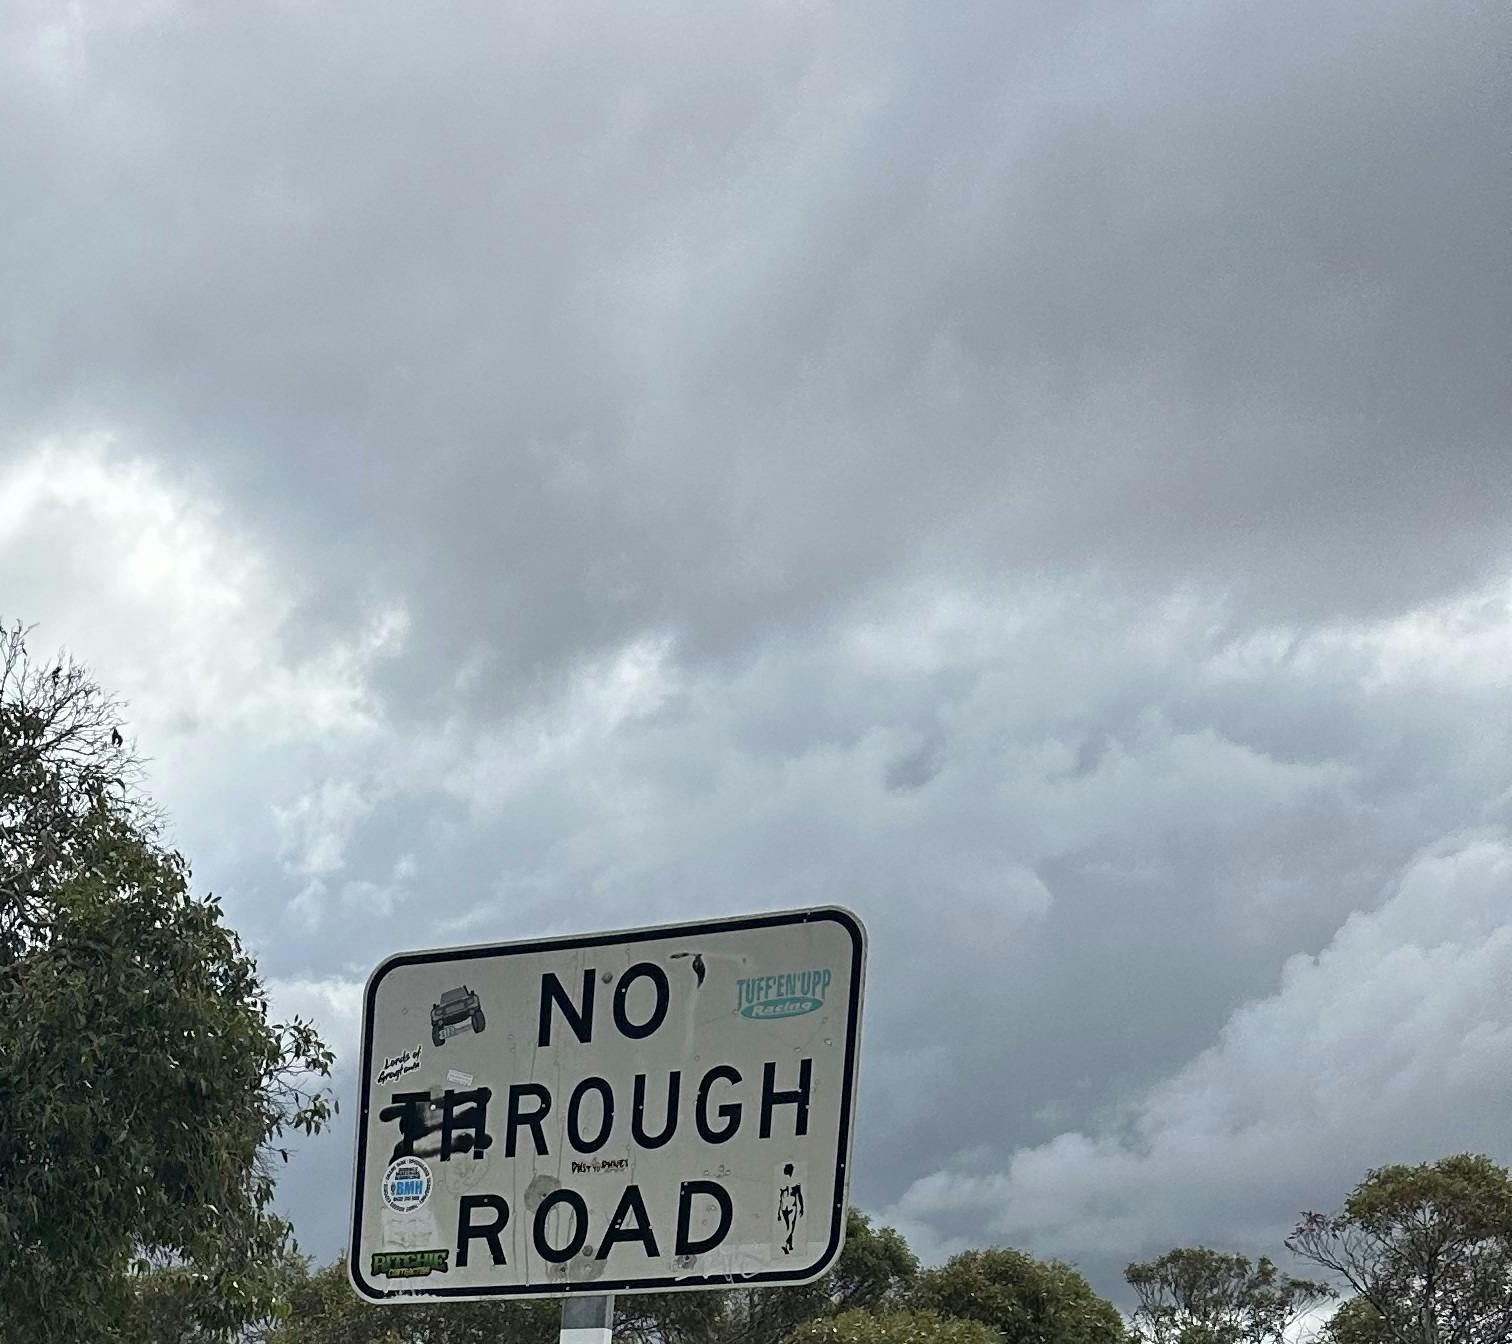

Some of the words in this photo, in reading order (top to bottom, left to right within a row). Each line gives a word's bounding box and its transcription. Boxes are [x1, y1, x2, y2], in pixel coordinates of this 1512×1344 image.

[538, 962, 670, 1048] NO
[751, 1001, 813, 1017] Racing
[396, 1180, 423, 1196] BMH
[456, 1181, 733, 1268] ROAD
[373, 1251, 447, 1274] RITCHIE
